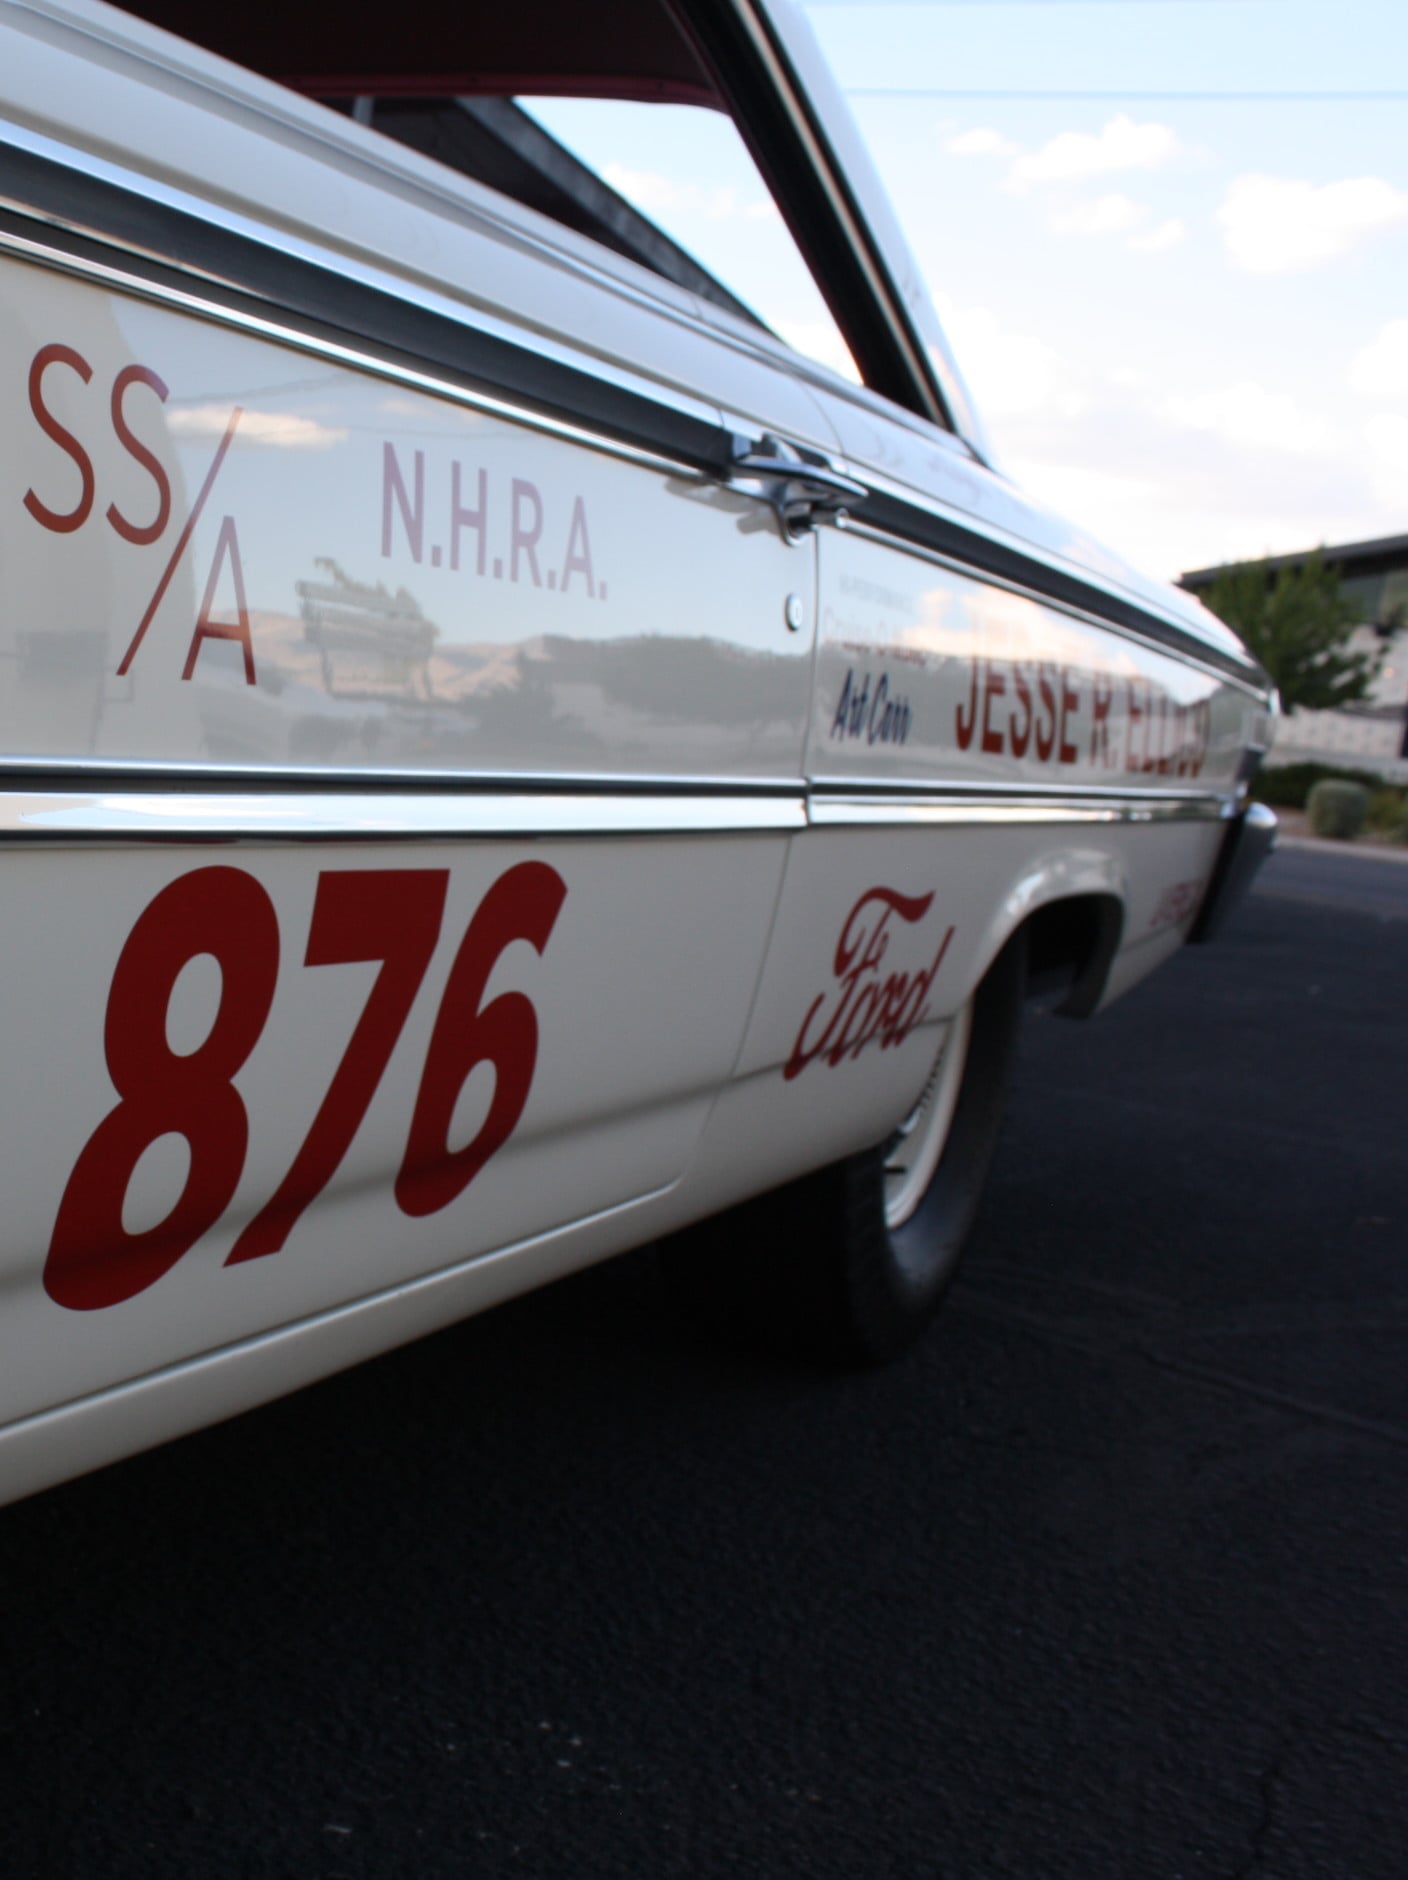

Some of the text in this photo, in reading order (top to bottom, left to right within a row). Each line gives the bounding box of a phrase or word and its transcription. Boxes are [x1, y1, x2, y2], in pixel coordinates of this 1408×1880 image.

[381, 440, 609, 601] N.H.R.A.
[783, 885, 955, 1082] Ford
[42, 860, 569, 1312] 876
